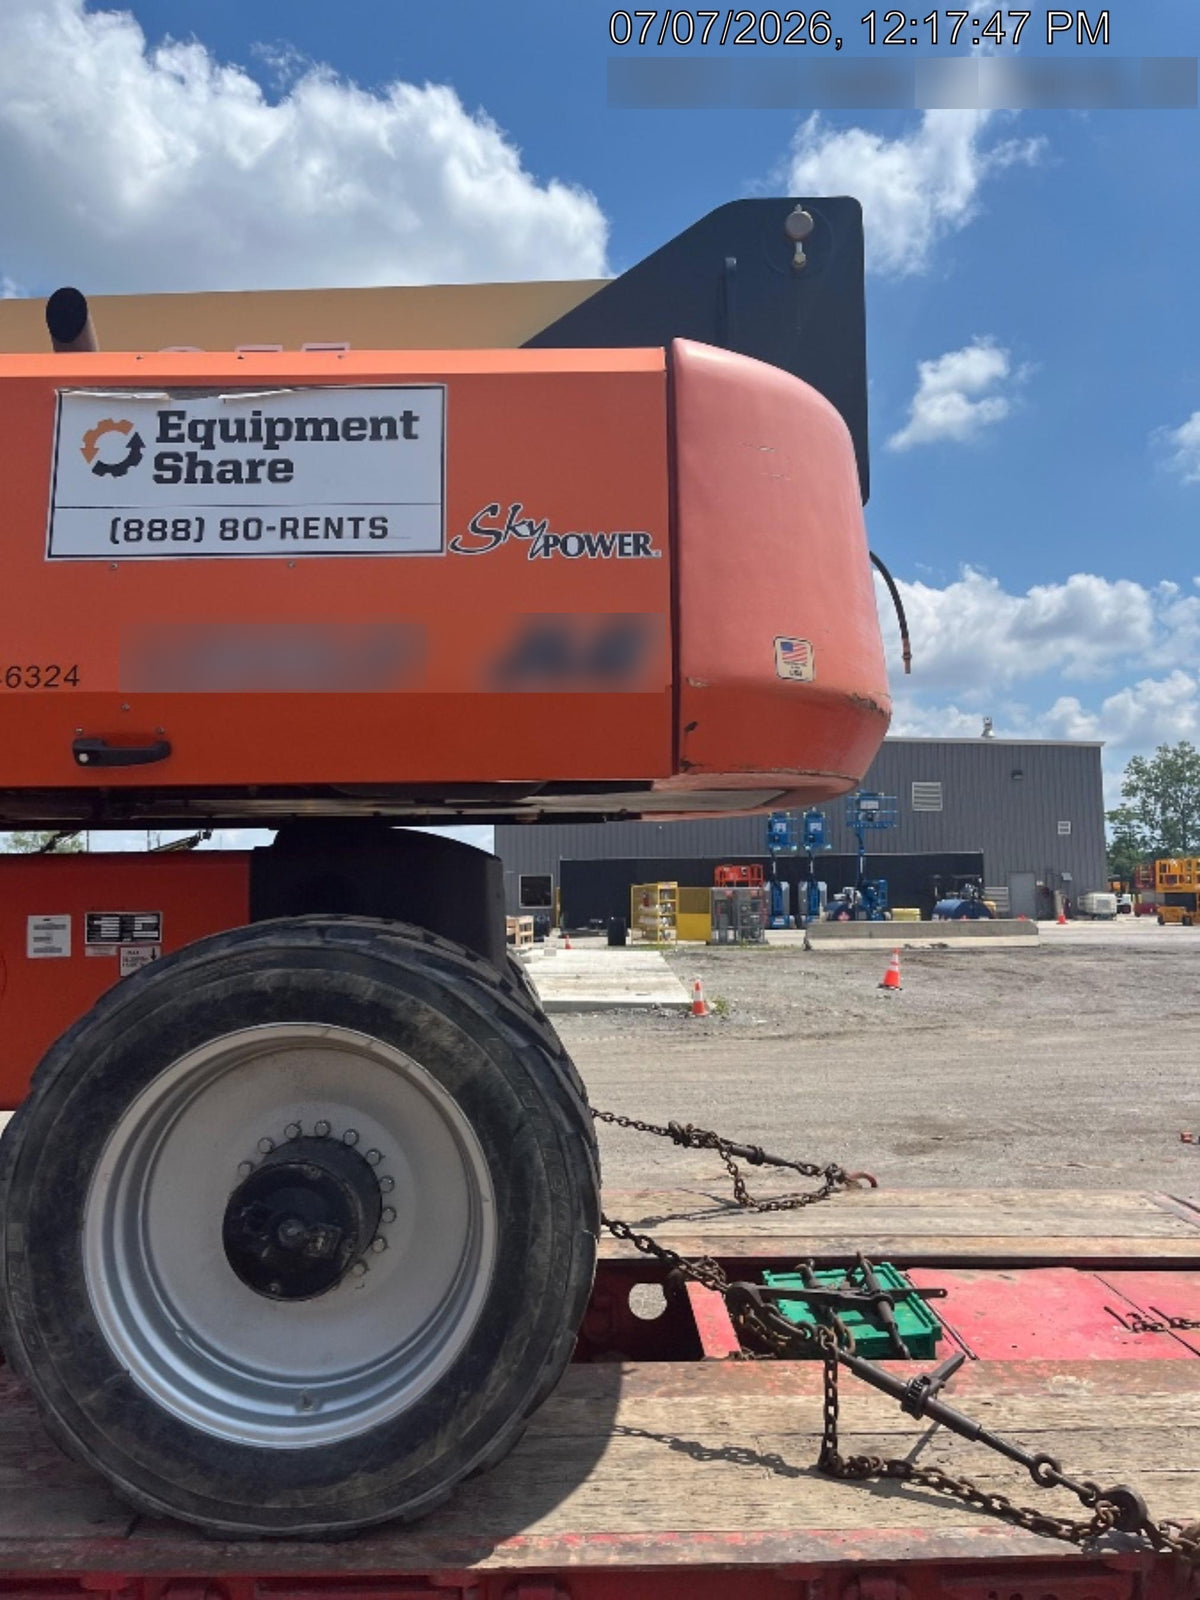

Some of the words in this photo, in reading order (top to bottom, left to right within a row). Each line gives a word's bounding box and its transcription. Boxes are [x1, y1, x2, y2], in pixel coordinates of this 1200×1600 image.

[155, 410, 420, 450] Equipment
[153, 451, 294, 484] Share
[110, 516, 204, 544] (888)
[219, 515, 389, 542] 80-RENTS
[0, 664, 81, 689] 6324
